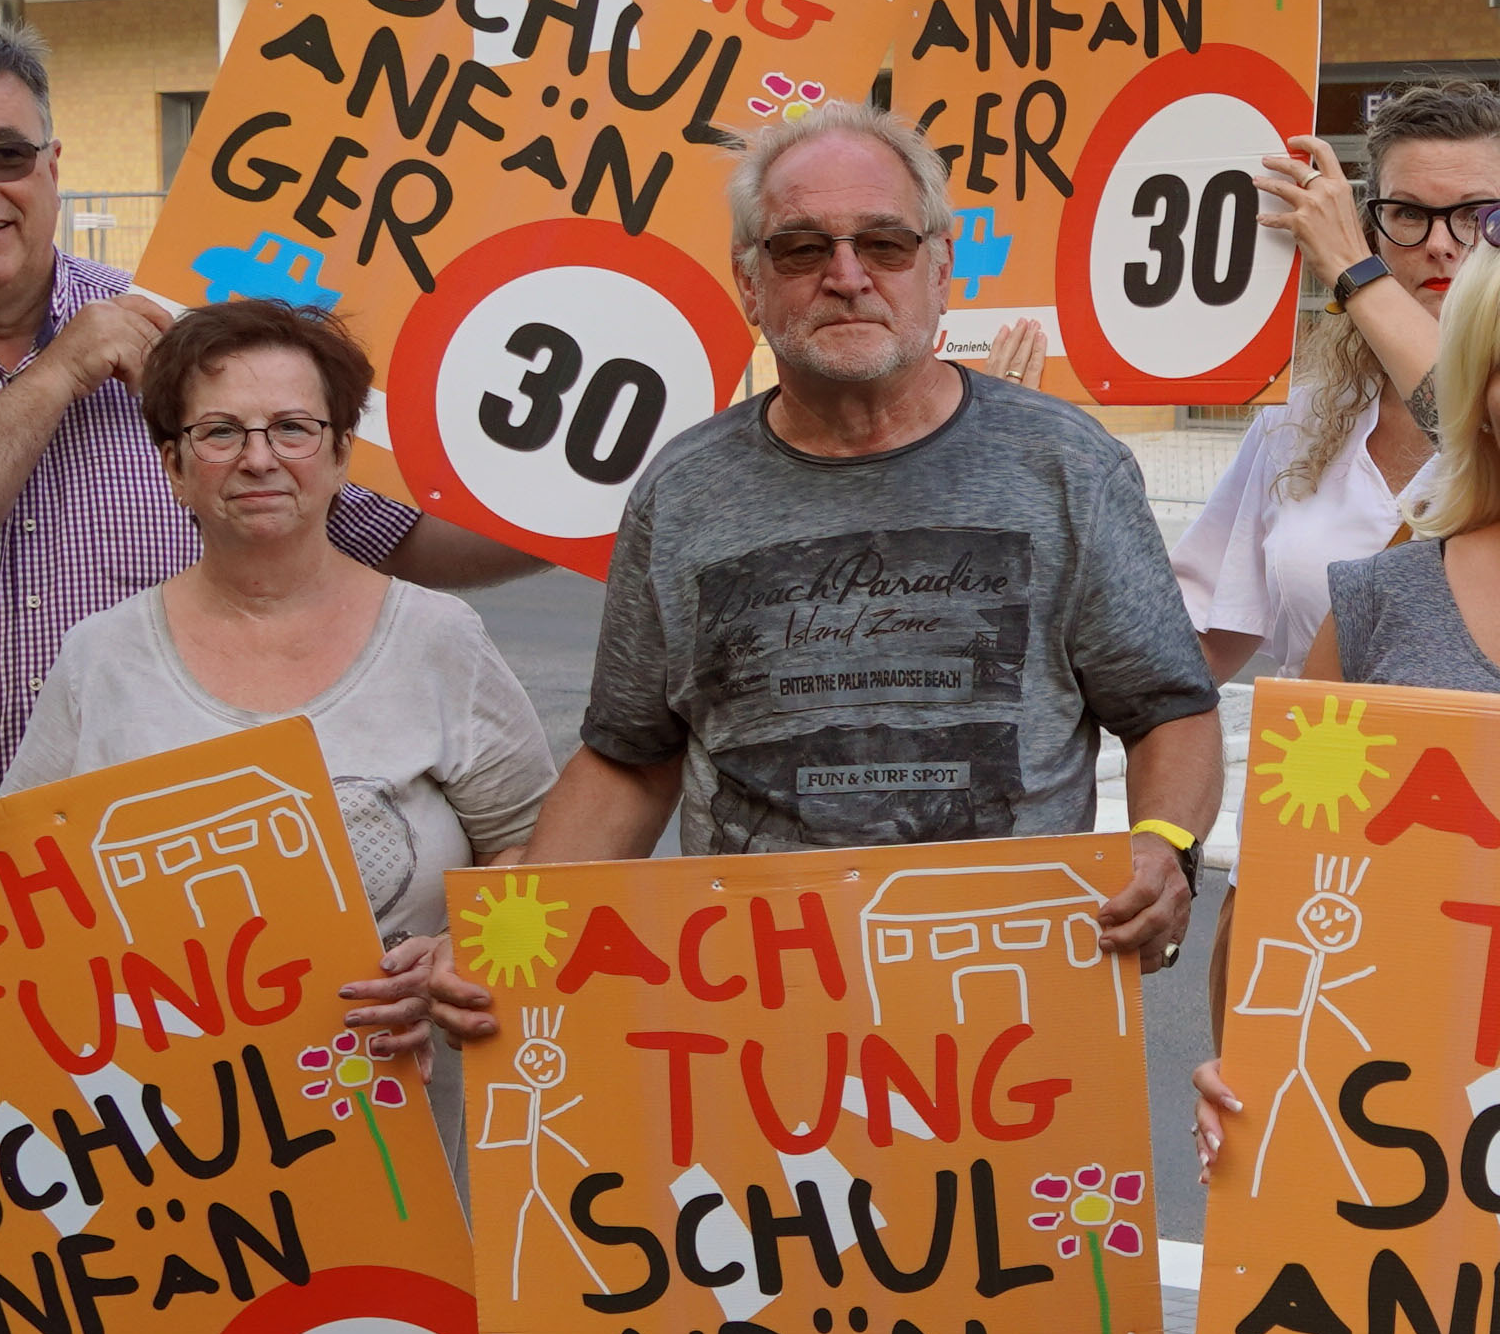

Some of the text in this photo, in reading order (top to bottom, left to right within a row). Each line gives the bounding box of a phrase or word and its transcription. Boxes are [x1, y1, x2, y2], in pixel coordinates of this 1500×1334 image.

[260, 12, 675, 237] ANFÄN
[211, 110, 452, 294] GER
[1122, 169, 1259, 307] 30
[477, 321, 669, 486] 30
[946, 340, 992, 353] Oranienb
[706, 547, 1009, 634] Beach Paradise
[785, 604, 943, 649] Island Zone
[780, 670, 961, 696] ENTER THE PALM PARADISE BEACH
[807, 769, 958, 787] FUN & SURF SPOT
[556, 891, 845, 1010] ACH
[626, 1023, 1072, 1168] TUNG
[569, 1158, 1053, 1313] SCHUL
